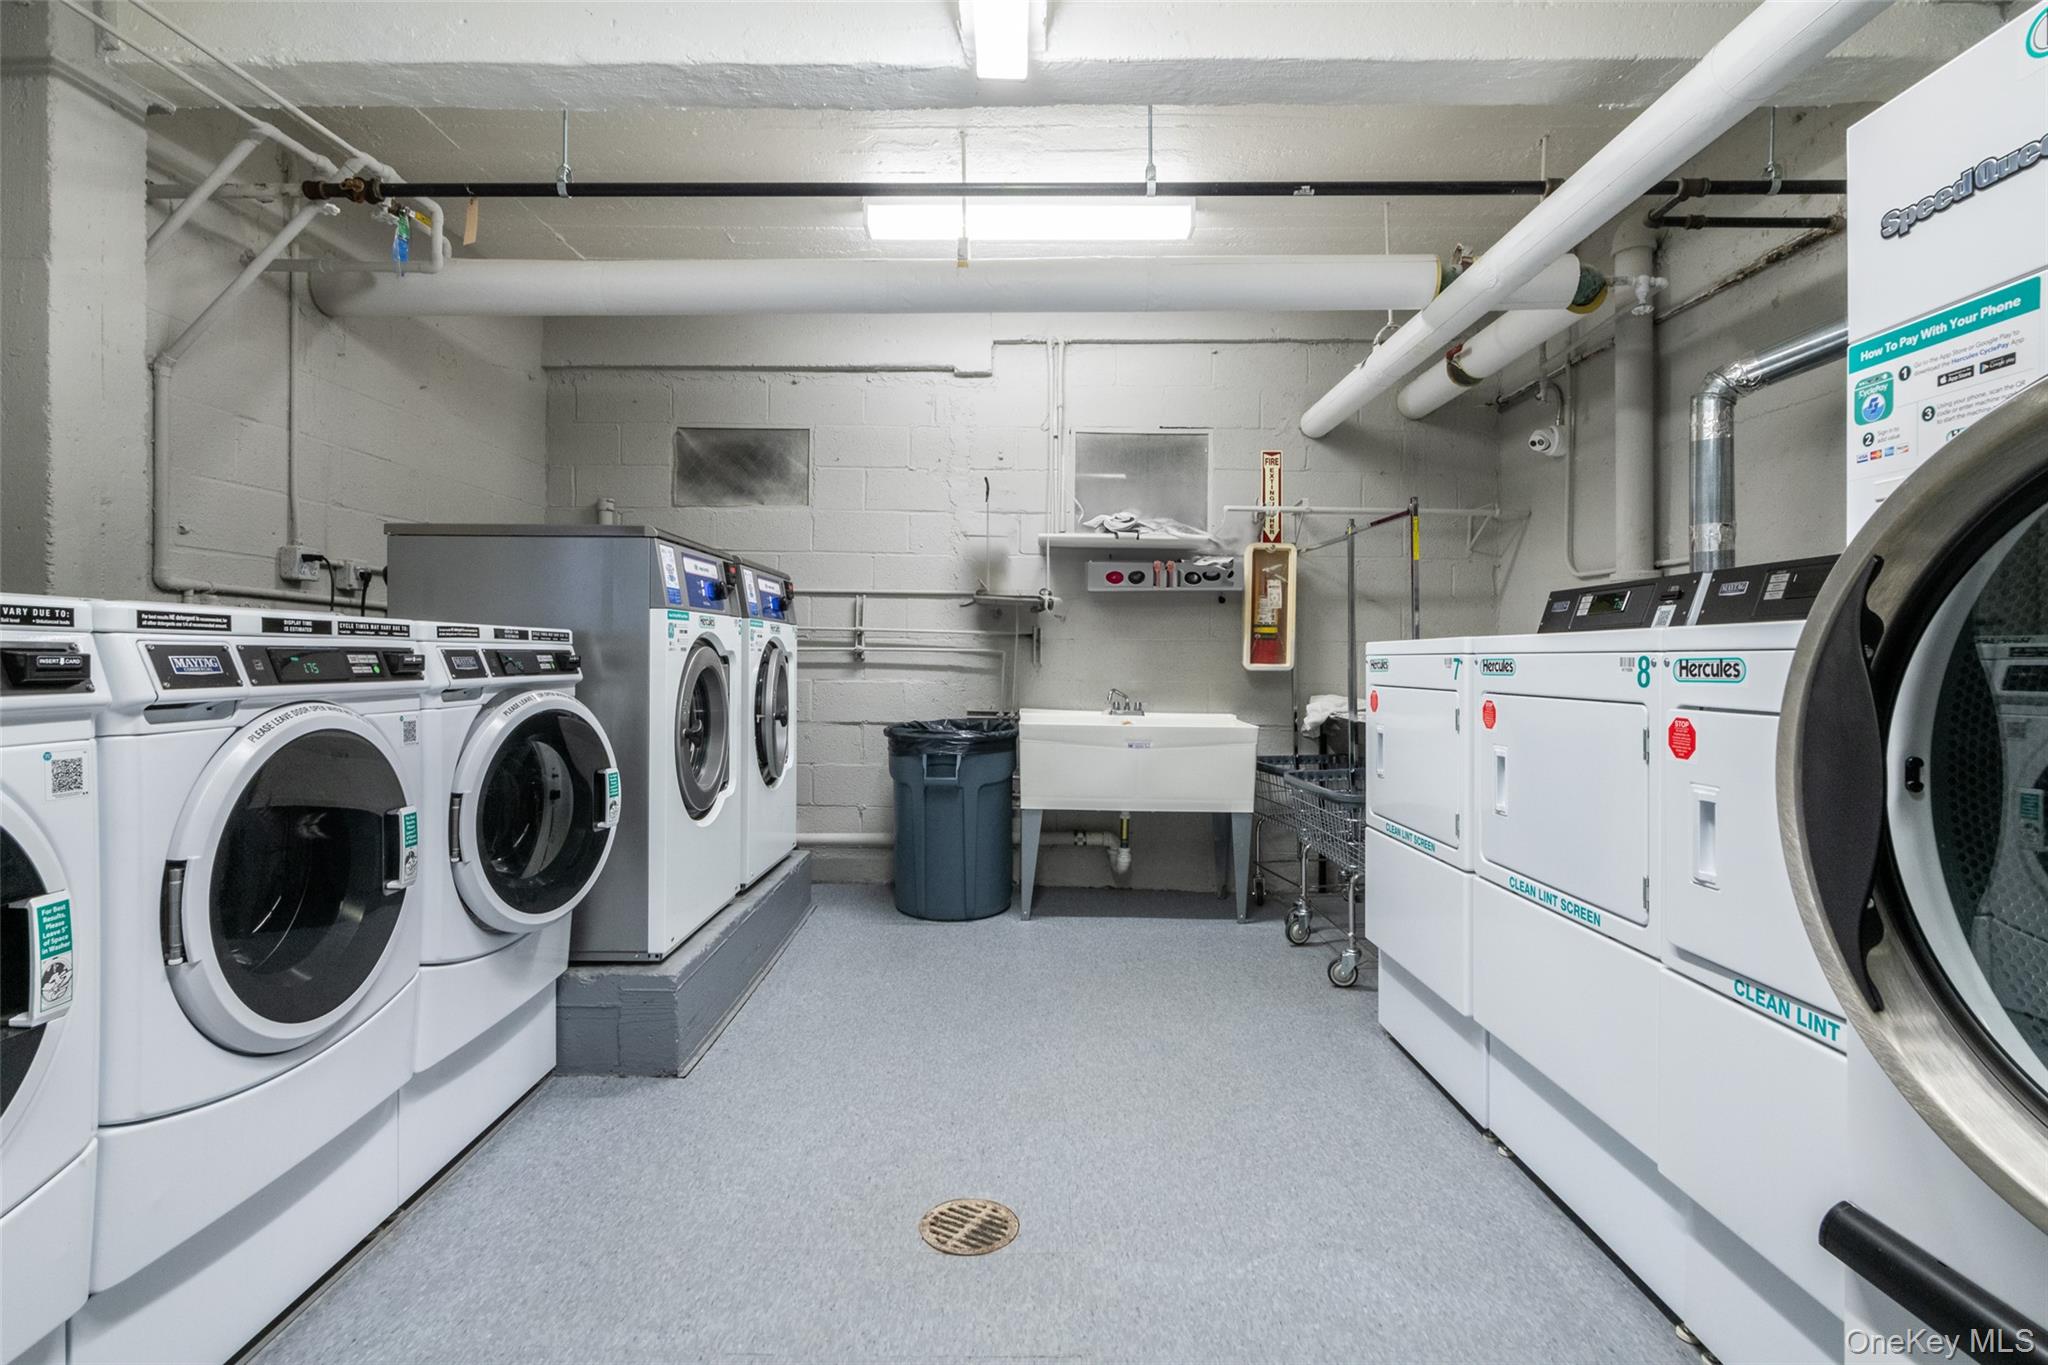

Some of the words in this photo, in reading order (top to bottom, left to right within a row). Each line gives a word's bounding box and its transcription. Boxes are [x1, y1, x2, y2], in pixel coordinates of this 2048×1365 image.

[1881, 167, 1975, 239] Speed
[1860, 347, 1883, 362] How
[1885, 341, 1898, 353] To
[1899, 334, 1919, 351] Pay
[1920, 323, 1947, 340] With
[1950, 313, 1978, 330] Your
[1980, 297, 2021, 319] Phone
[1951, 352, 1979, 364] Hercules
[1979, 342, 2010, 356] CyclePay
[2012, 336, 2025, 346] App
[1952, 346, 1968, 356] Store
[1976, 336, 1999, 348] Google
[2000, 332, 2012, 342] Play
[1953, 398, 1965, 406] your
[1989, 387, 2003, 395] scan
[2004, 383, 2014, 391] the
[1937, 409, 1951, 417] code
[1959, 402, 1974, 411] enter
[1264, 457, 1279, 466] FIRE
[2, 607, 28, 616] VARY
[32, 608, 51, 617] DUE
[55, 609, 70, 618] TO:
[173, 658, 218, 668] MAYTAG
[1370, 659, 1388, 670] Hercules
[1453, 658, 1462, 681] 7
[1482, 658, 1514, 673] Hercules
[1679, 658, 1741, 678] Hercules
[1637, 655, 1650, 688] 8
[503, 702, 520, 717] PLEASE
[248, 721, 275, 743] PLEASE
[271, 711, 293, 727] LEAVE
[290, 706, 310, 717] DOOR
[1674, 719, 1690, 728] STOP
[1386, 822, 1401, 837] CLEAN
[1402, 829, 1413, 842] LINT
[1413, 834, 1435, 852] SCREEN
[53, 904, 66, 912] Best
[1509, 876, 1536, 897] CLEAN
[1538, 888, 1558, 907] LINT
[1560, 898, 1601, 927] SCREEN
[45, 921, 65, 930] Please
[43, 929, 61, 939] Leave
[43, 939, 50, 947] of
[51, 934, 69, 944] Space
[48, 941, 71, 952] Washer
[1734, 979, 1790, 1019] CLEAN
[1797, 1007, 1841, 1041] LINT
